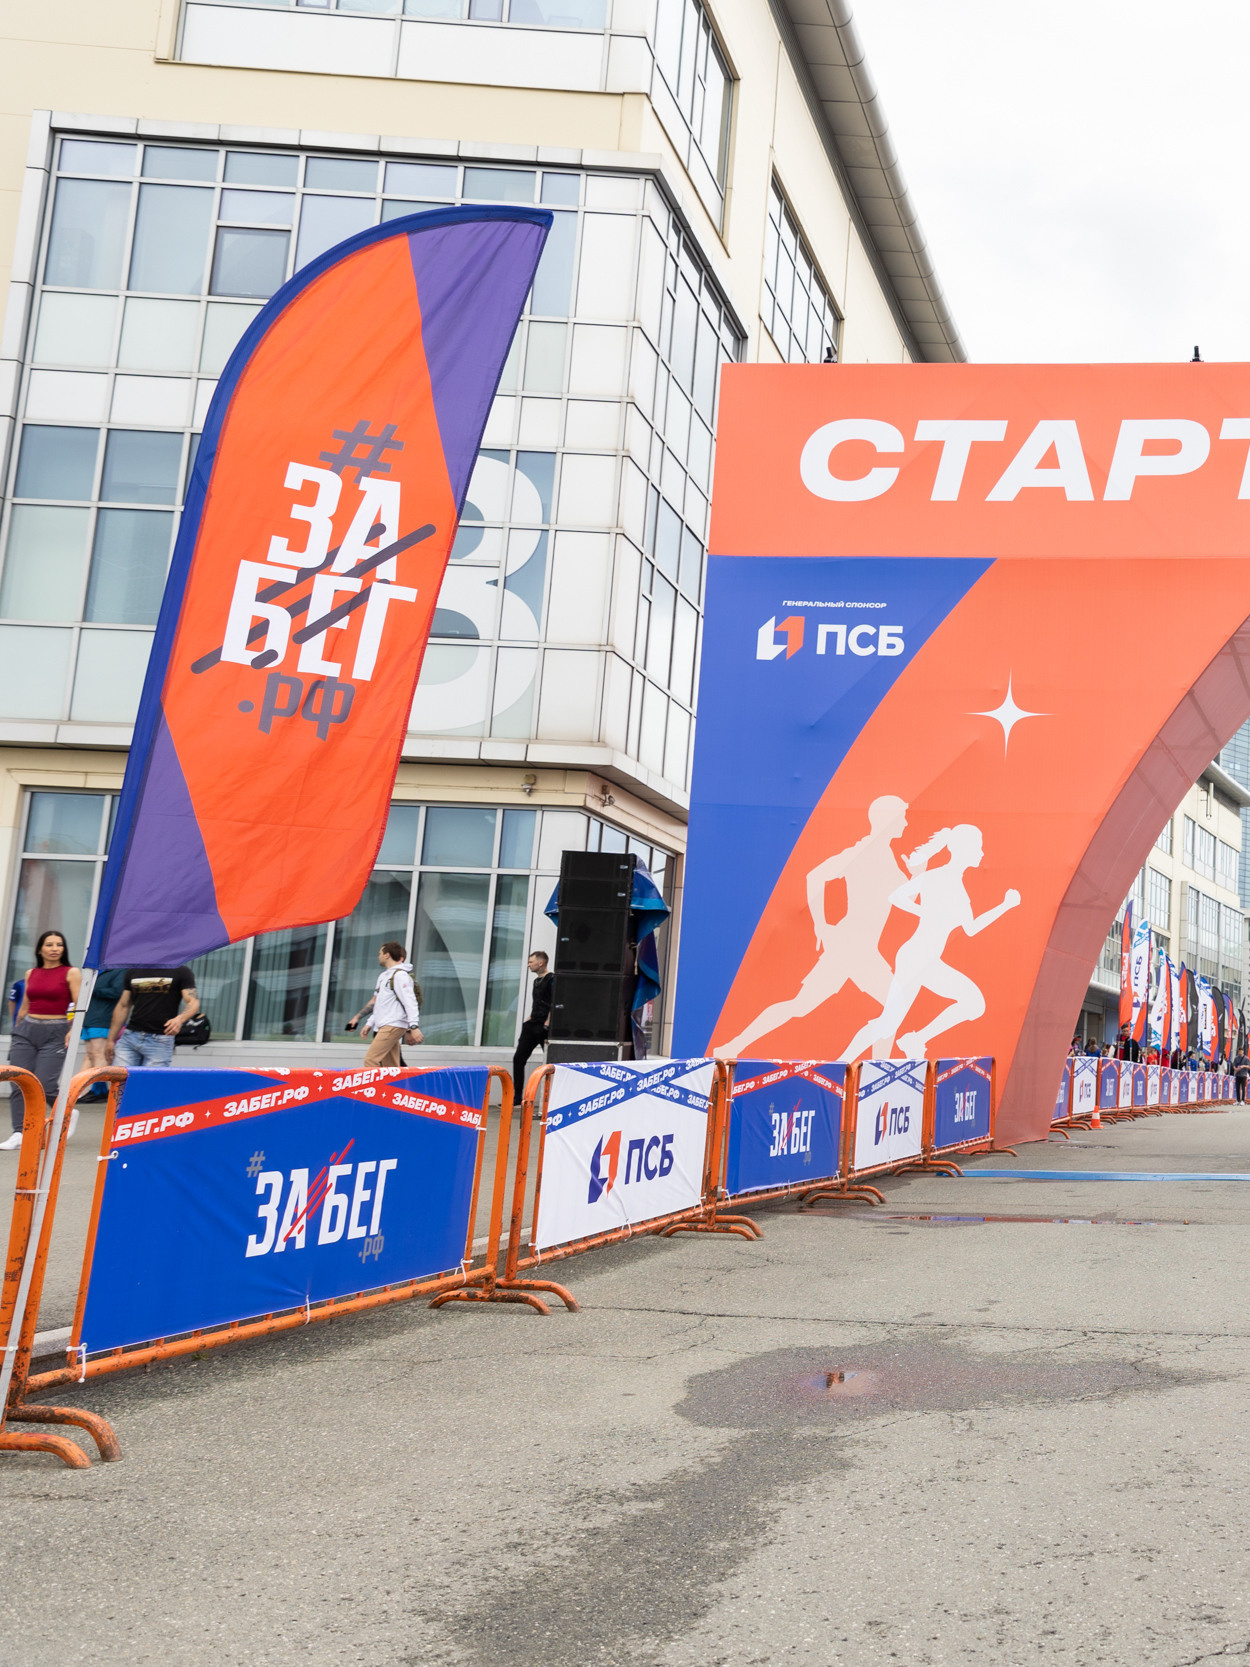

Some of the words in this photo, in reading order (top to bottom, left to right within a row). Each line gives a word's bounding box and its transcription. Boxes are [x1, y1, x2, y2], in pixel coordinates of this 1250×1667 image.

[782, 600, 844, 608] ГЕНЕРАЛЬНЫЙ
[845, 601, 887, 609] СПОНСОР
[816, 624, 905, 657] ПСБ
[578, 1087, 626, 1116] ЗАБЕГ.РФ
[636, 1066, 676, 1092] ЗАБЕГ.РФ
[732, 1081, 756, 1095] БЕГ.РФ
[762, 1069, 788, 1085] ЗАБЕГ.РФ
[111, 1111, 195, 1142] БЕГ.РФ
[223, 1085, 309, 1118] ЗАБЕГ.РФ
[332, 1067, 402, 1092] ЗАБЕГ.РФ
[392, 1092, 447, 1116] ЗАБЕГ.РФ
[889, 1105, 911, 1136] ПСБ
[625, 1133, 674, 1185] ПСБ
